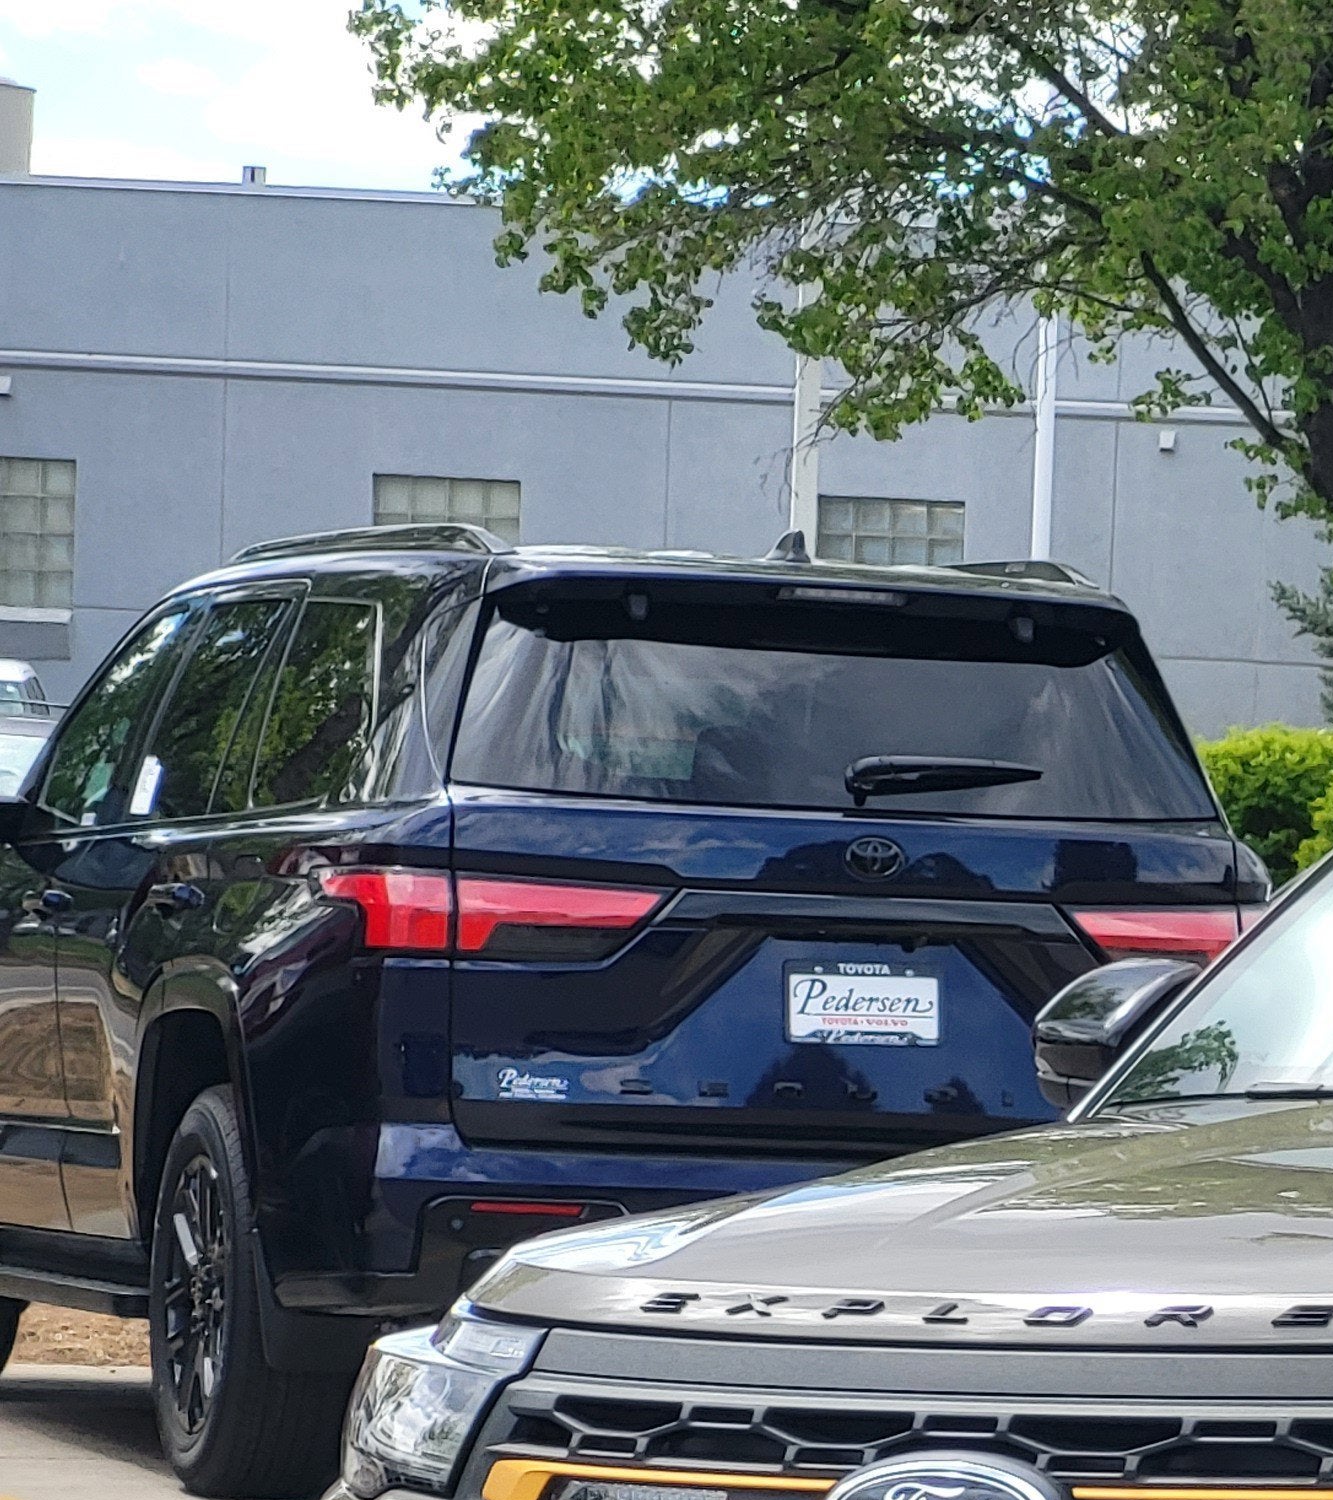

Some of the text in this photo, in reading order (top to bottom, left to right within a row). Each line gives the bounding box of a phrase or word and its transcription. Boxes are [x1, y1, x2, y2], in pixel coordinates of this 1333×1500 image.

[836, 962, 891, 975] TOYOTA
[793, 978, 935, 1015] Pedersen
[821, 1017, 859, 1026] TOYOTA
